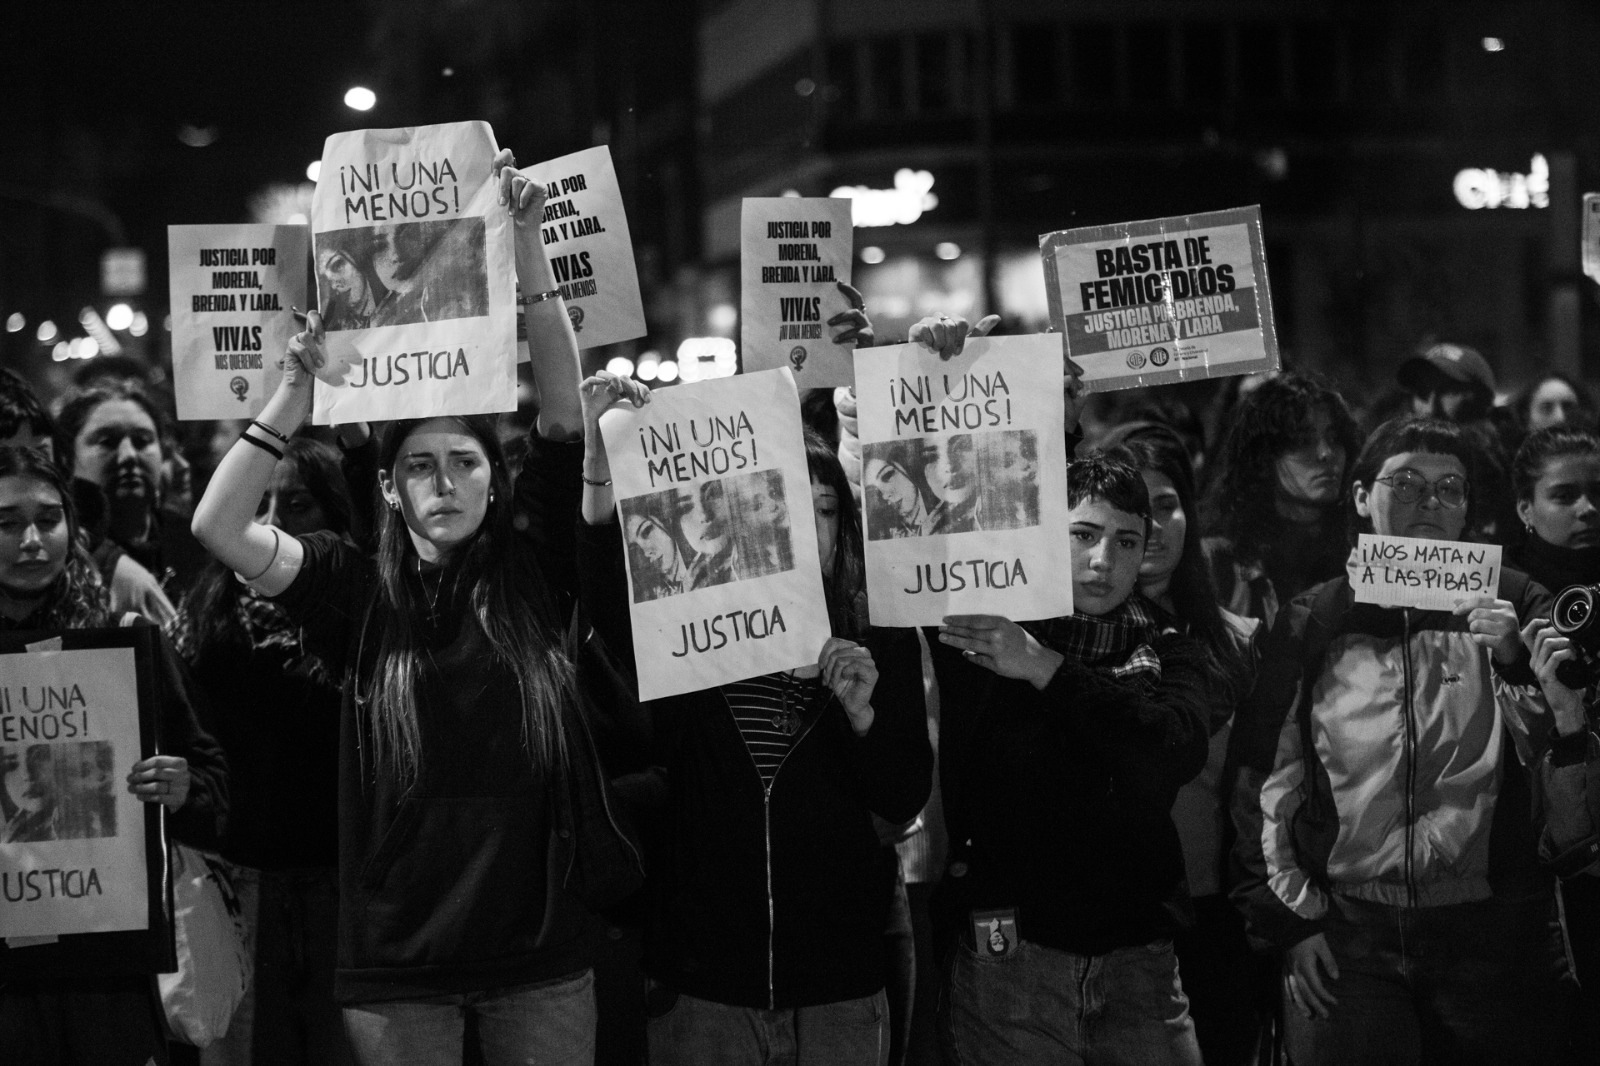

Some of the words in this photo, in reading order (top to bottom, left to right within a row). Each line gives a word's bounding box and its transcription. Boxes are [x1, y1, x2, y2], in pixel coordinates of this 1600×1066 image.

[339, 163, 380, 196] ¡NI
[392, 157, 458, 191] UNA
[560, 173, 588, 196] POR
[344, 185, 460, 224] MENOS!
[541, 199, 580, 224] RENA,
[559, 222, 569, 241] Y
[570, 215, 606, 239] LARA.
[767, 221, 809, 239] JUSTICIA
[811, 221, 832, 239] POR
[199, 248, 249, 267] JUSTICIA
[252, 247, 276, 266] POR
[549, 250, 594, 284] IVAS
[778, 243, 821, 262] MORENA,
[1096, 239, 1183, 279] BASTA
[1184, 235, 1213, 267] DE
[212, 271, 263, 291] MORENA,
[762, 265, 801, 283] BRENDA
[802, 265, 809, 283] Y
[811, 265, 838, 283] LARA.
[192, 294, 237, 313] BRENDA
[239, 293, 248, 312] Y
[250, 293, 283, 312] LARA.
[560, 284, 572, 302] NA
[570, 278, 598, 300] MENOS!
[780, 297, 821, 322] VIVAS
[1084, 306, 1152, 334] JUSTICIA
[1175, 293, 1240, 320] BRENDA,
[212, 325, 262, 352] VIVAS
[1106, 322, 1171, 350] MORENA
[1170, 320, 1181, 340] Y
[1184, 314, 1223, 338] LARA
[214, 354, 228, 371] NOS
[229, 353, 263, 371] QUEREMOS
[350, 347, 470, 388] JUSTICIA
[889, 375, 932, 407] ¡NI
[943, 370, 1010, 402] UNA
[895, 398, 1011, 436] MENOS!
[639, 422, 681, 458] ¡NI
[690, 410, 755, 448] UNA
[648, 438, 758, 488] MENOS!
[1362, 541, 1409, 563] ¡NOS
[1414, 545, 1486, 564] MATAN
[903, 558, 1028, 594] JUSTICIA
[1361, 566, 1375, 585] A
[671, 604, 787, 658] JUSTICIA
[22, 683, 86, 714] UNA
[1, 710, 88, 742] ENOS!
[2, 867, 103, 903] USTICIA
